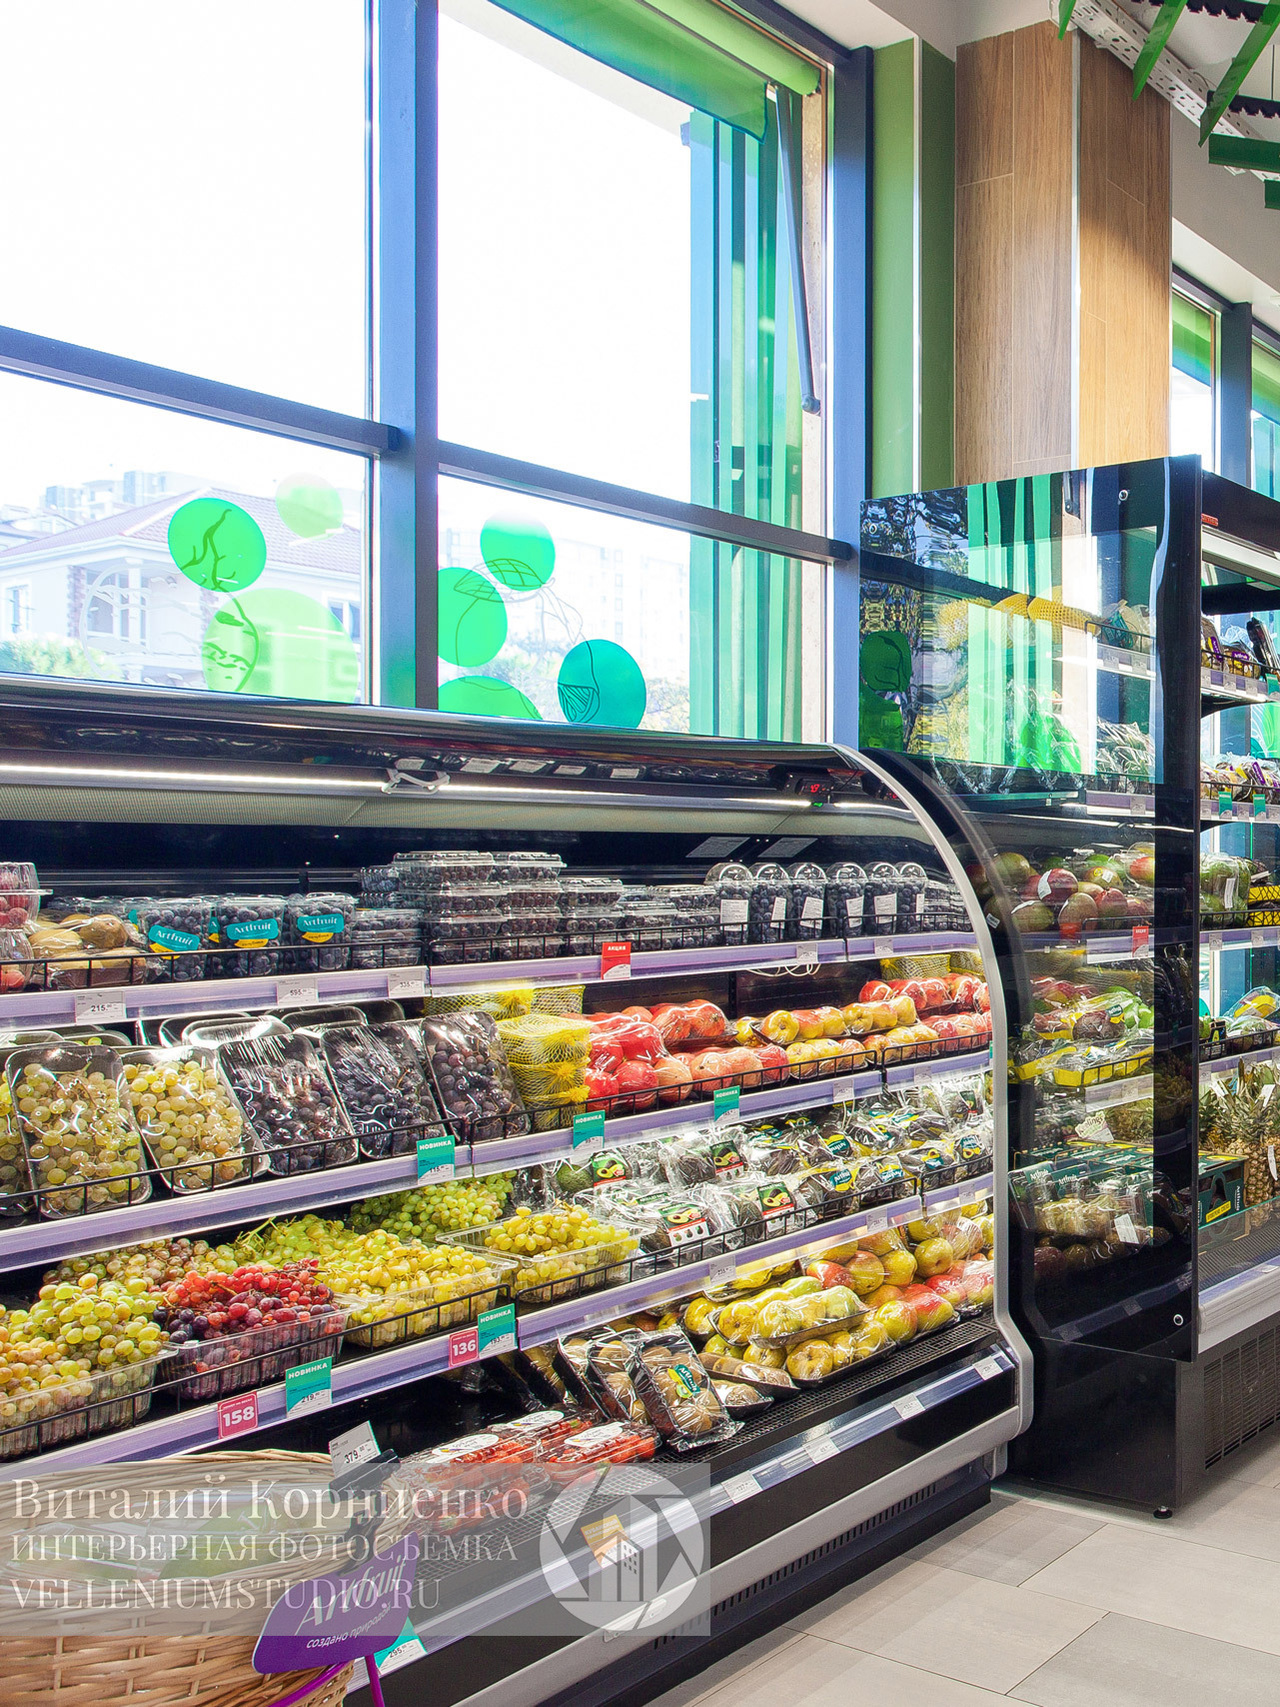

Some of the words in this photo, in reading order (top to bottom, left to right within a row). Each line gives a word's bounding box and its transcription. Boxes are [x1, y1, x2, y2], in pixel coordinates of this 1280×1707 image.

[575, 1114, 603, 1125] НОВИНКА
[419, 1140, 452, 1152] НОВИНКА
[480, 1308, 511, 1324] НОВИНКА
[452, 1340, 476, 1358] 136
[288, 1361, 328, 1379] НОВИНКА
[223, 1405, 255, 1428] 158
[295, 1555, 407, 1636] Artfruit
[306, 1632, 348, 1649] создано
